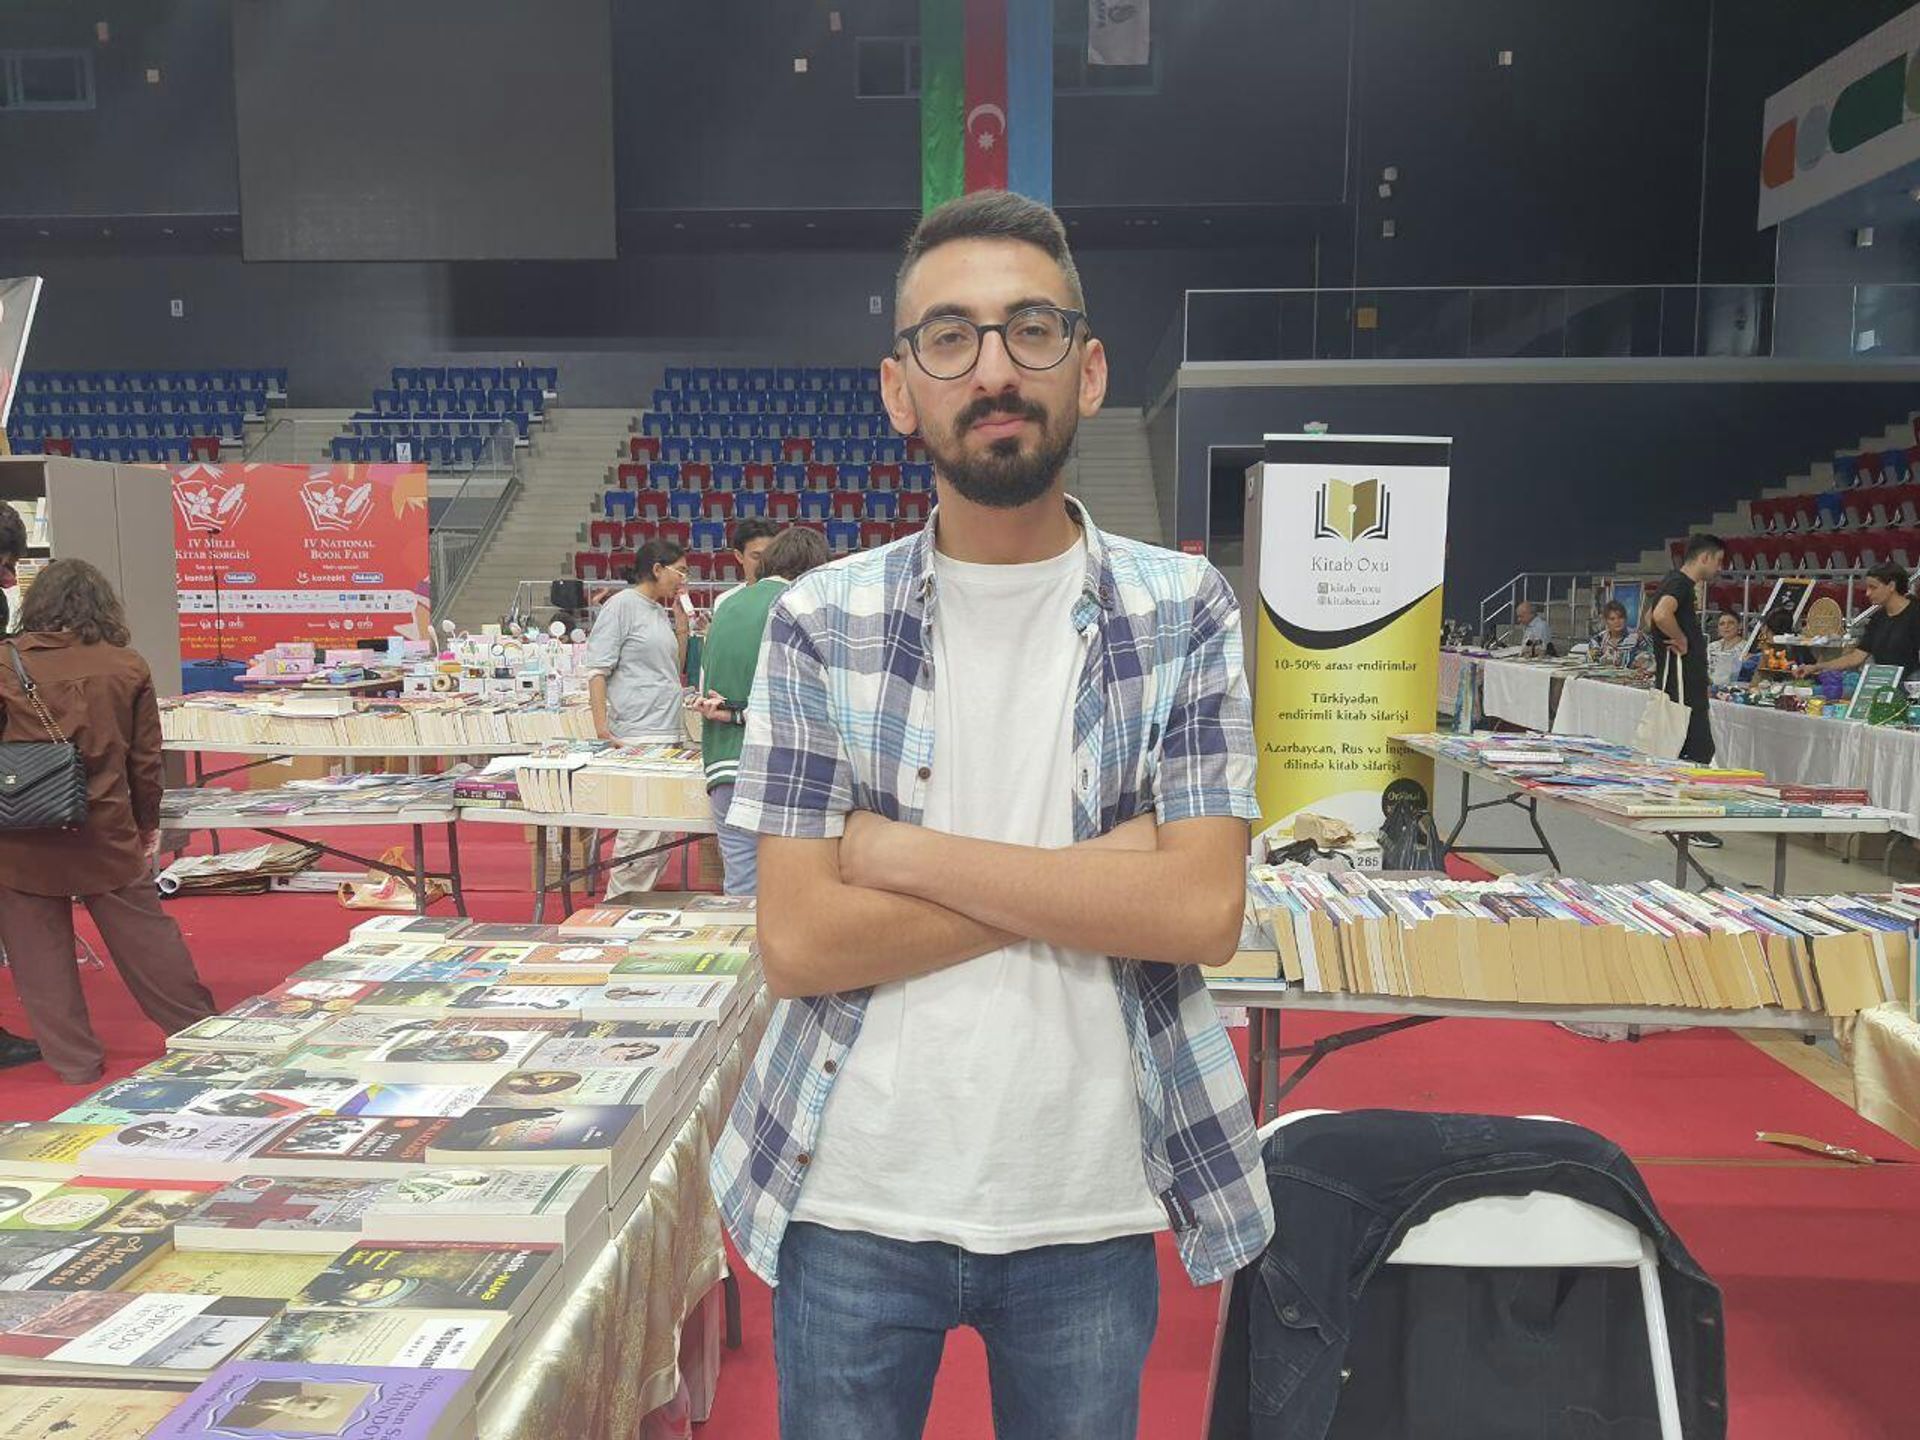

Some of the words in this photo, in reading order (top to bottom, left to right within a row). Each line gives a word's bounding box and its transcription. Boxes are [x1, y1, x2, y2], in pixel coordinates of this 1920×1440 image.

[188, 538, 202, 548] IV
[304, 538, 318, 548] IV
[1310, 556, 1353, 572] Kitab
[1357, 557, 1389, 572] Oxu
[184, 574, 218, 582] kontak
[1274, 658, 1321, 671] 10-50%
[1278, 710, 1332, 721] endirimli
[1337, 710, 1367, 721] kitab
[1342, 743, 1363, 754] Rus
[1328, 759, 1359, 771] kitab
[1357, 857, 1380, 867] 265
